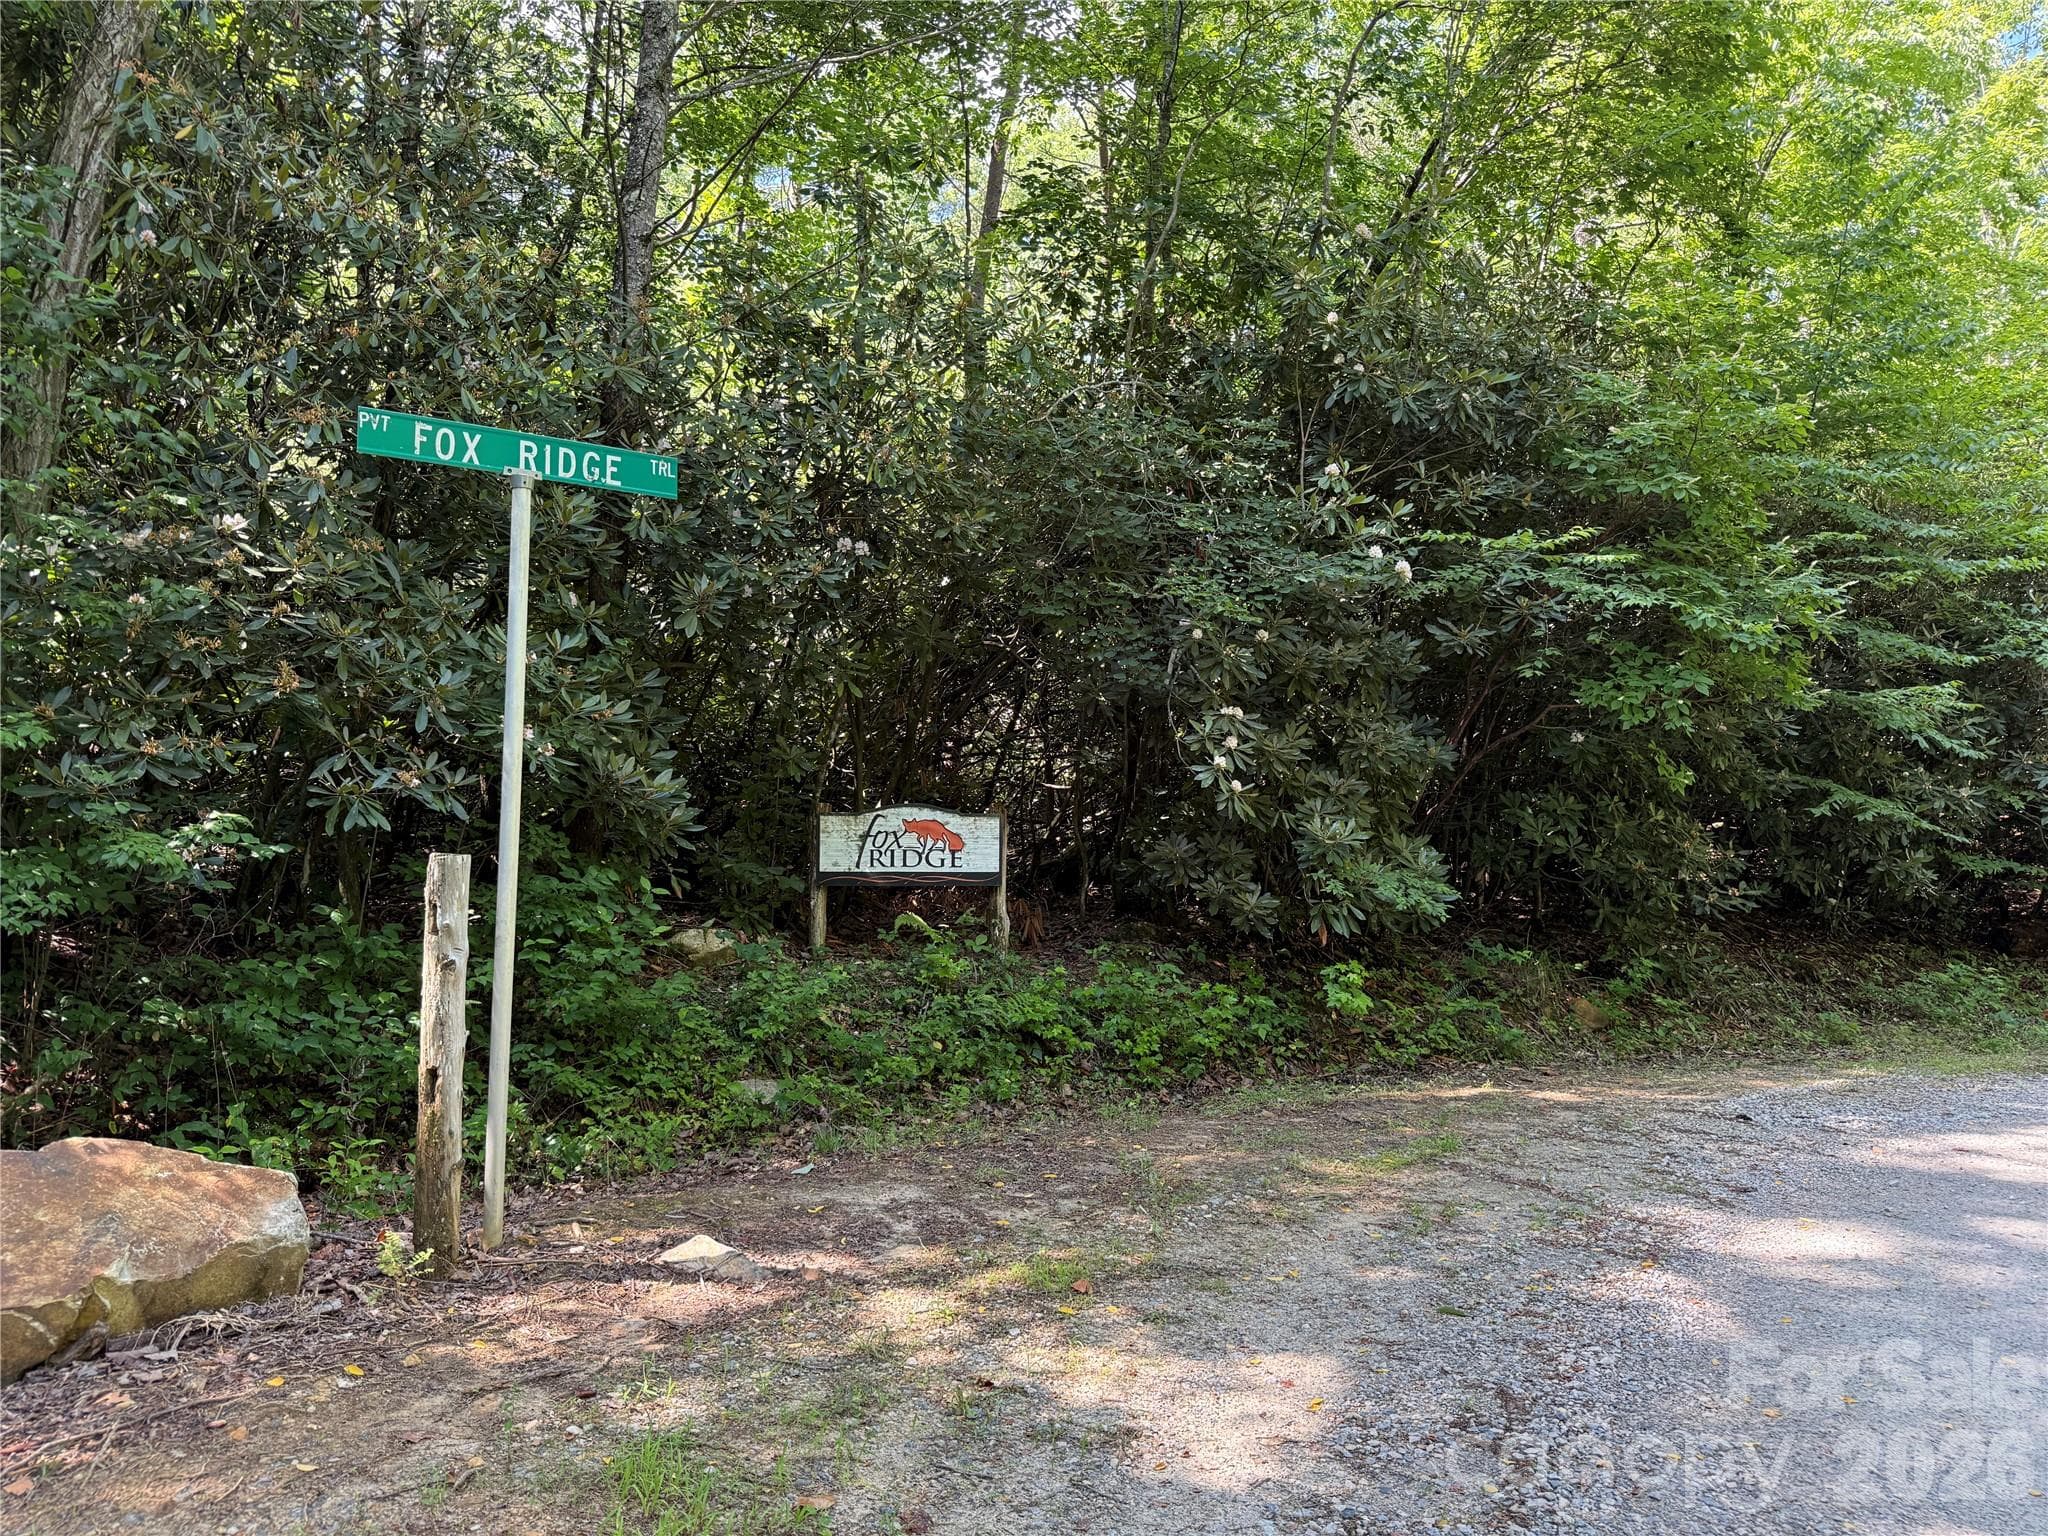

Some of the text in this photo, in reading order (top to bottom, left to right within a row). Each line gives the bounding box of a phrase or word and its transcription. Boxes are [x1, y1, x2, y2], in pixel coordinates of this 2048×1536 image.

[359, 412, 676, 487] PVT FOX RIDGE TRL
[869, 849, 963, 869] RIDGE
